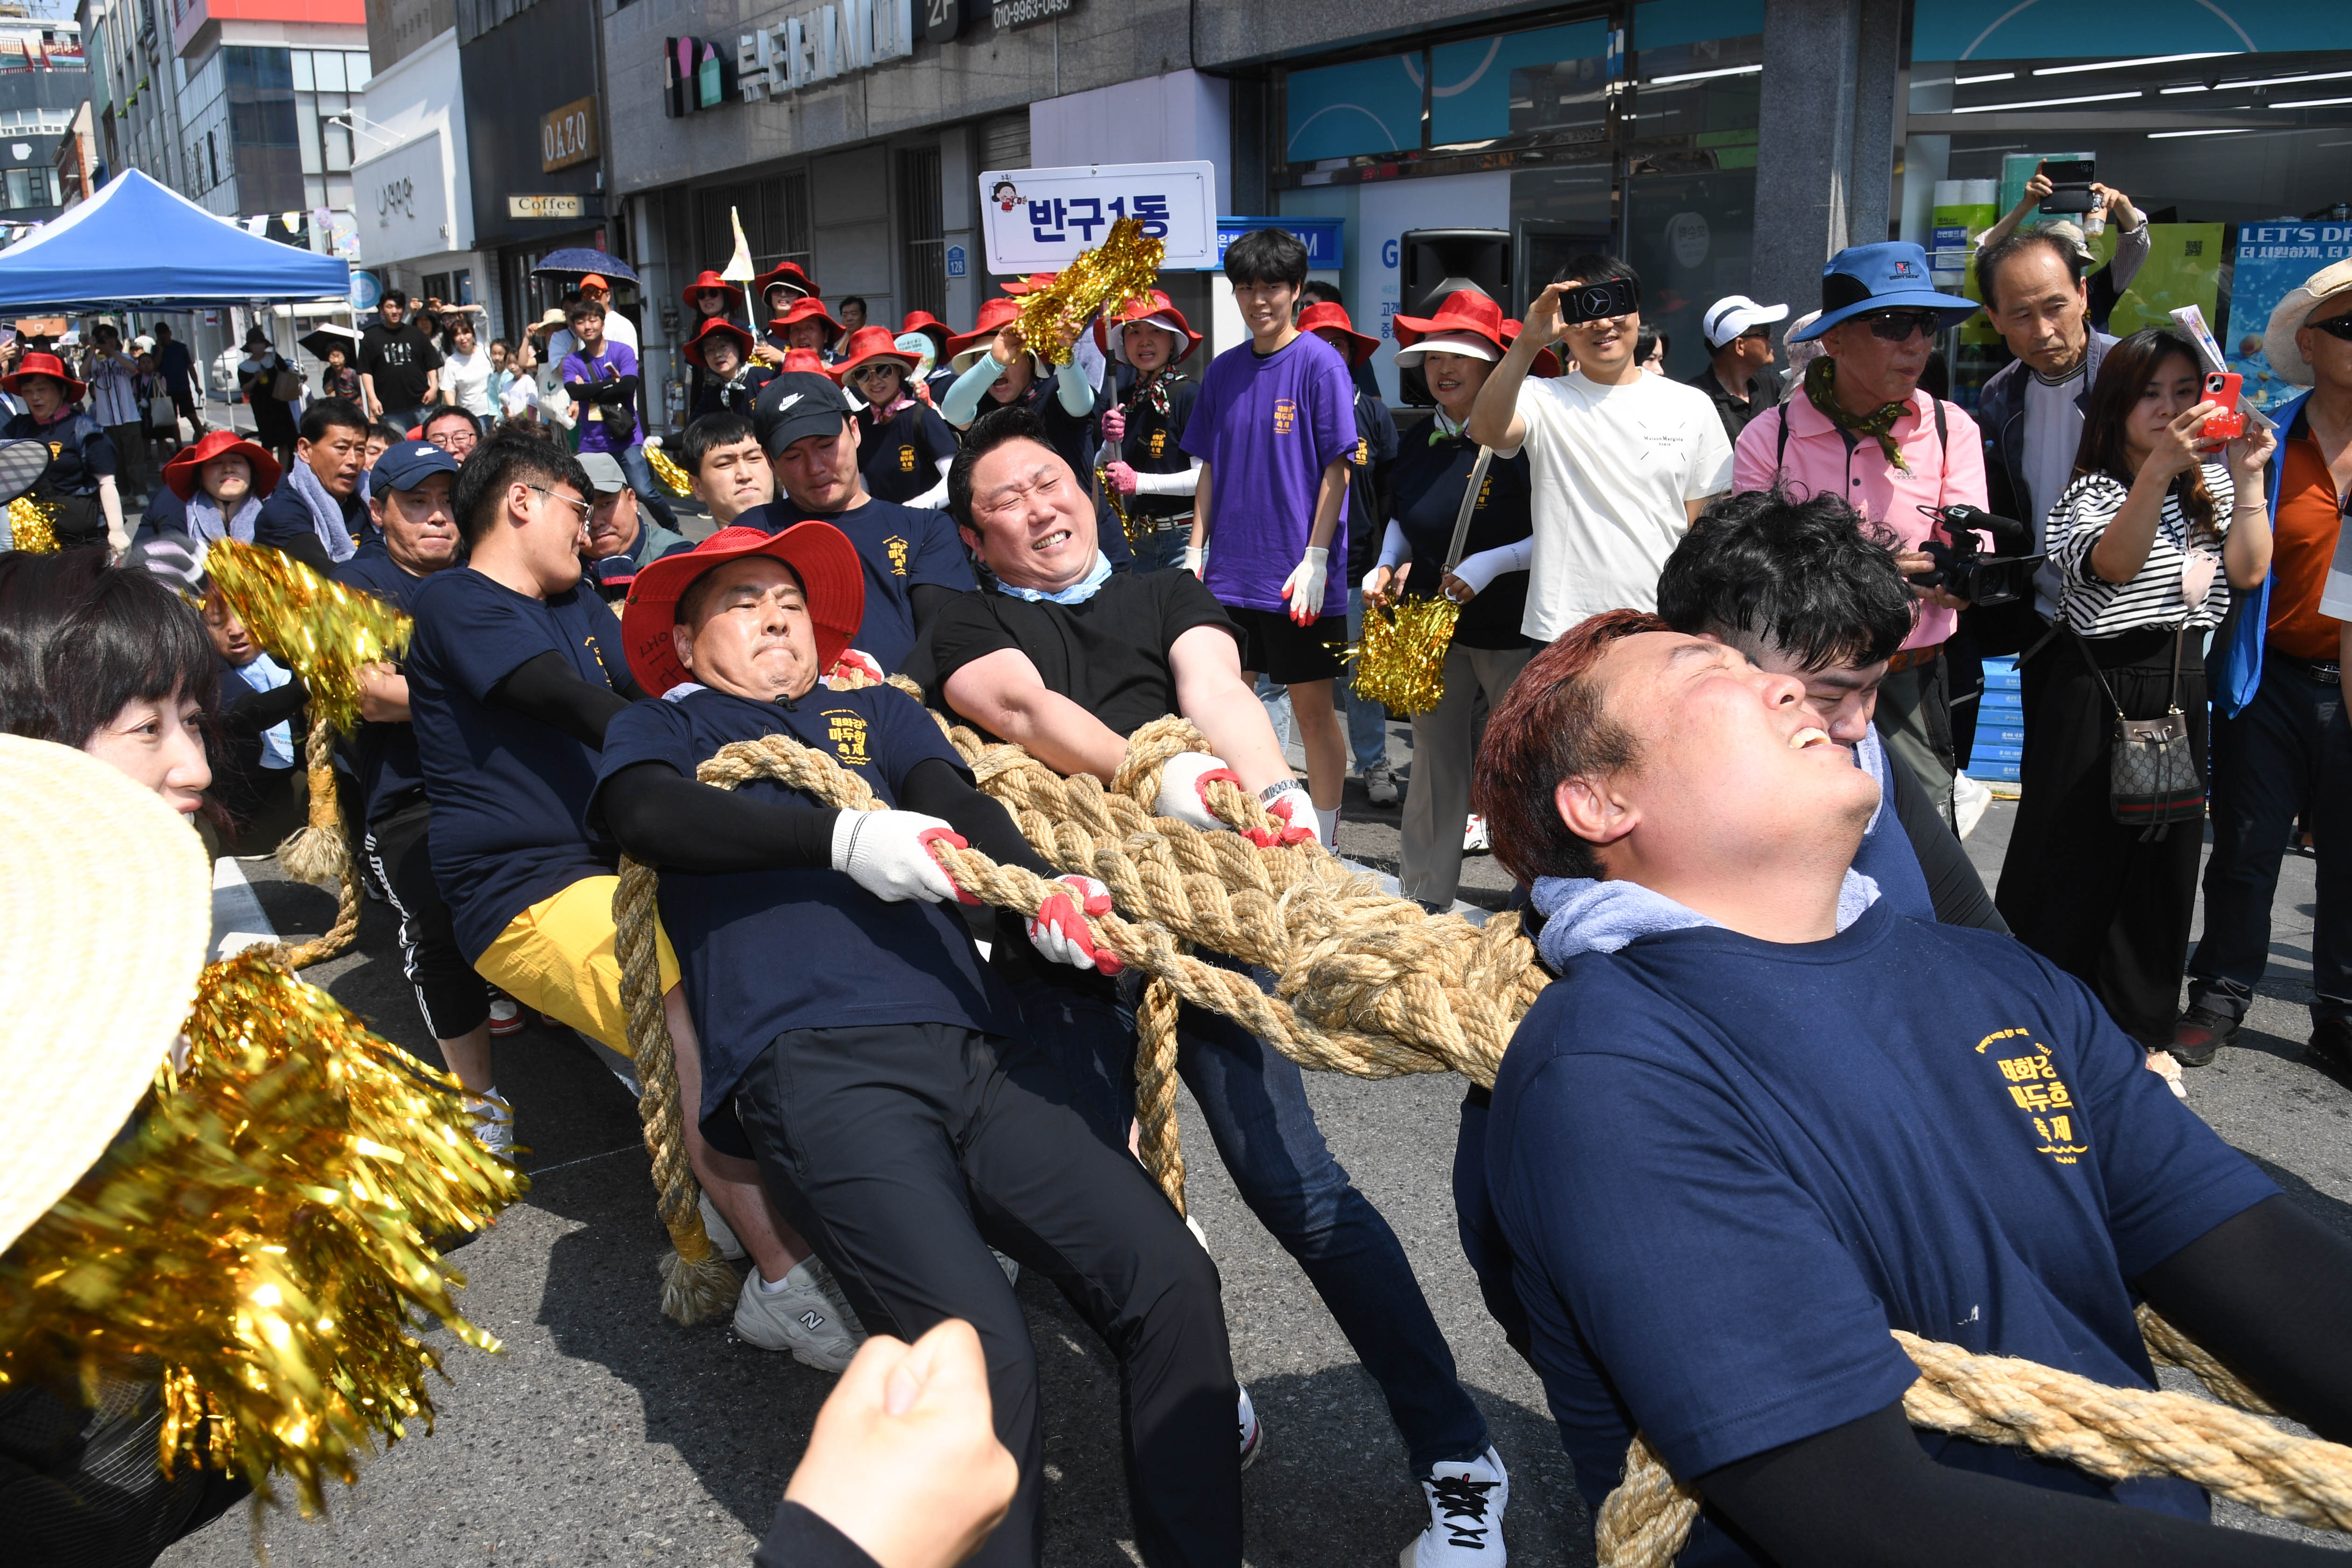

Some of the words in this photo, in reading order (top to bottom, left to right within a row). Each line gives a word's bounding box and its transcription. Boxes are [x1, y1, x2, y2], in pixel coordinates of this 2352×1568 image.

[519, 197, 576, 211] Coffee
[1028, 195, 1170, 243] 반구1동
[2241, 227, 2316, 242] LET'S
[2240, 246, 2255, 258] 더
[2258, 246, 2323, 260] 시원하게,
[2328, 246, 2343, 258] 더
[951, 261, 963, 274] 128
[782, 393, 798, 406] NIKE
[831, 717, 863, 729] 태화강
[828, 728, 866, 747] 마두희
[838, 743, 865, 756] 축제
[1997, 1055, 2057, 1082] 태화강
[2033, 1115, 2072, 1142] 축제
[799, 1310, 825, 1330] N
